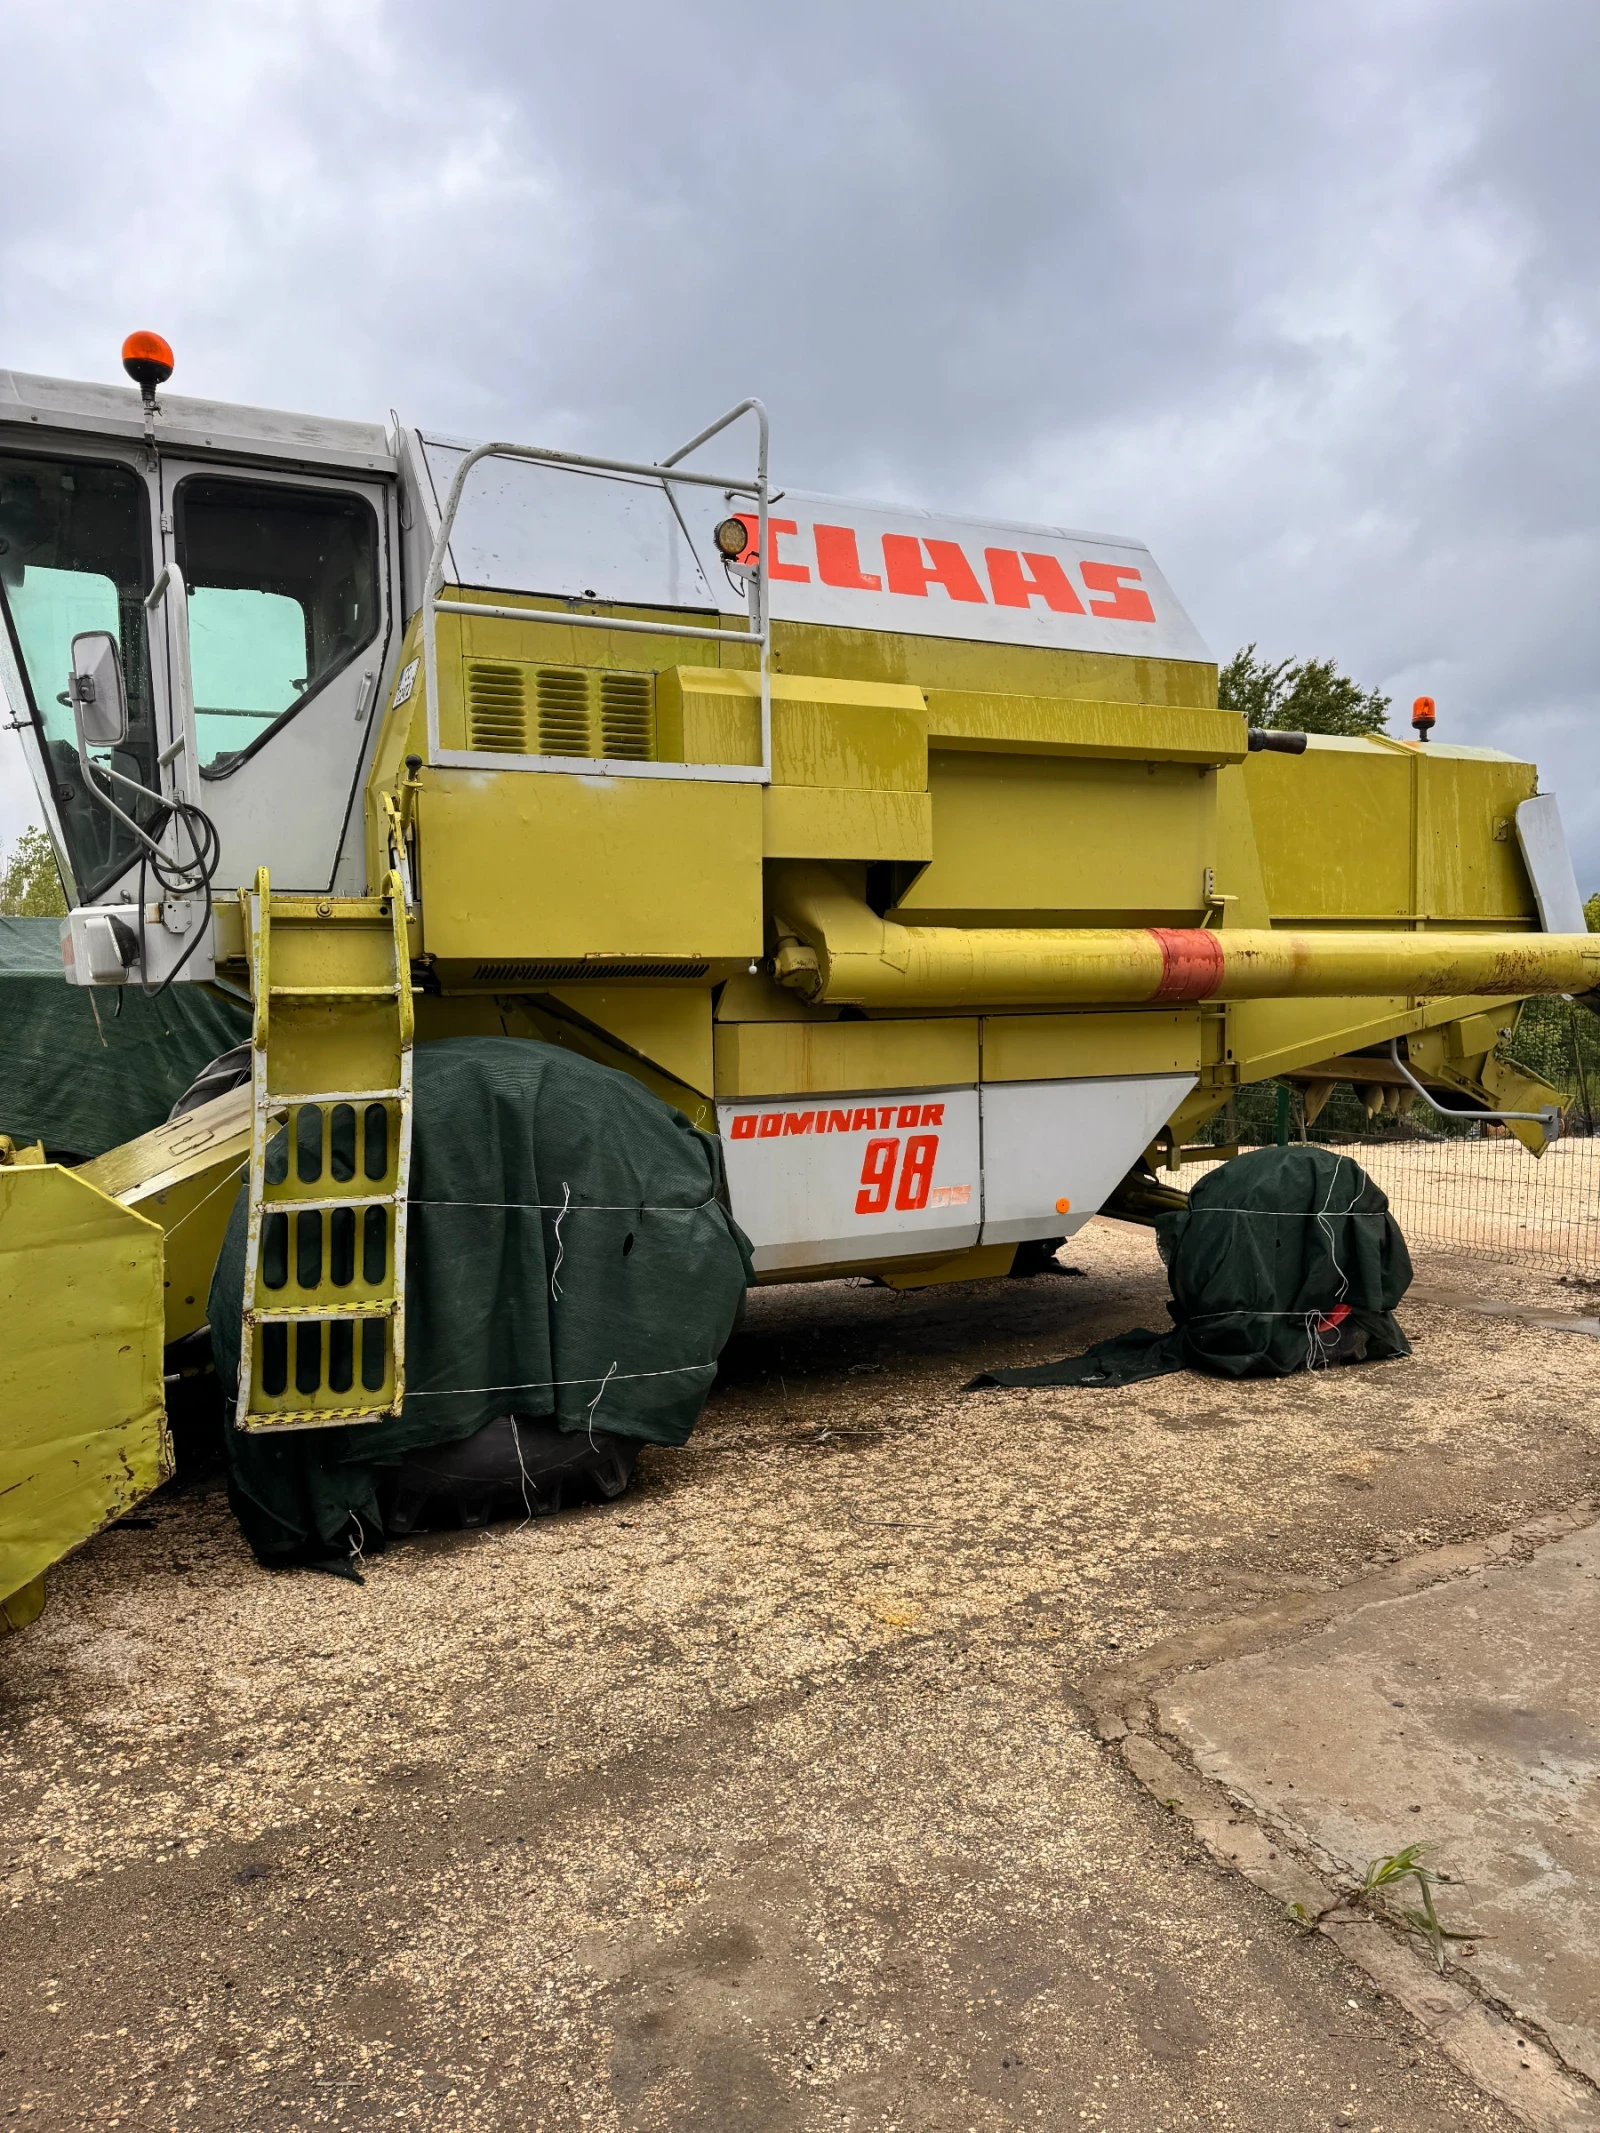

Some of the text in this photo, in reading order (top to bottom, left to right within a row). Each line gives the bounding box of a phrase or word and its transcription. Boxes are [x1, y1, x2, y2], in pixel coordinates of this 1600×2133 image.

[732, 512, 1156, 623] CLAAS
[730, 1104, 945, 1140] DOMINATOR
[855, 1134, 939, 1214] 98
